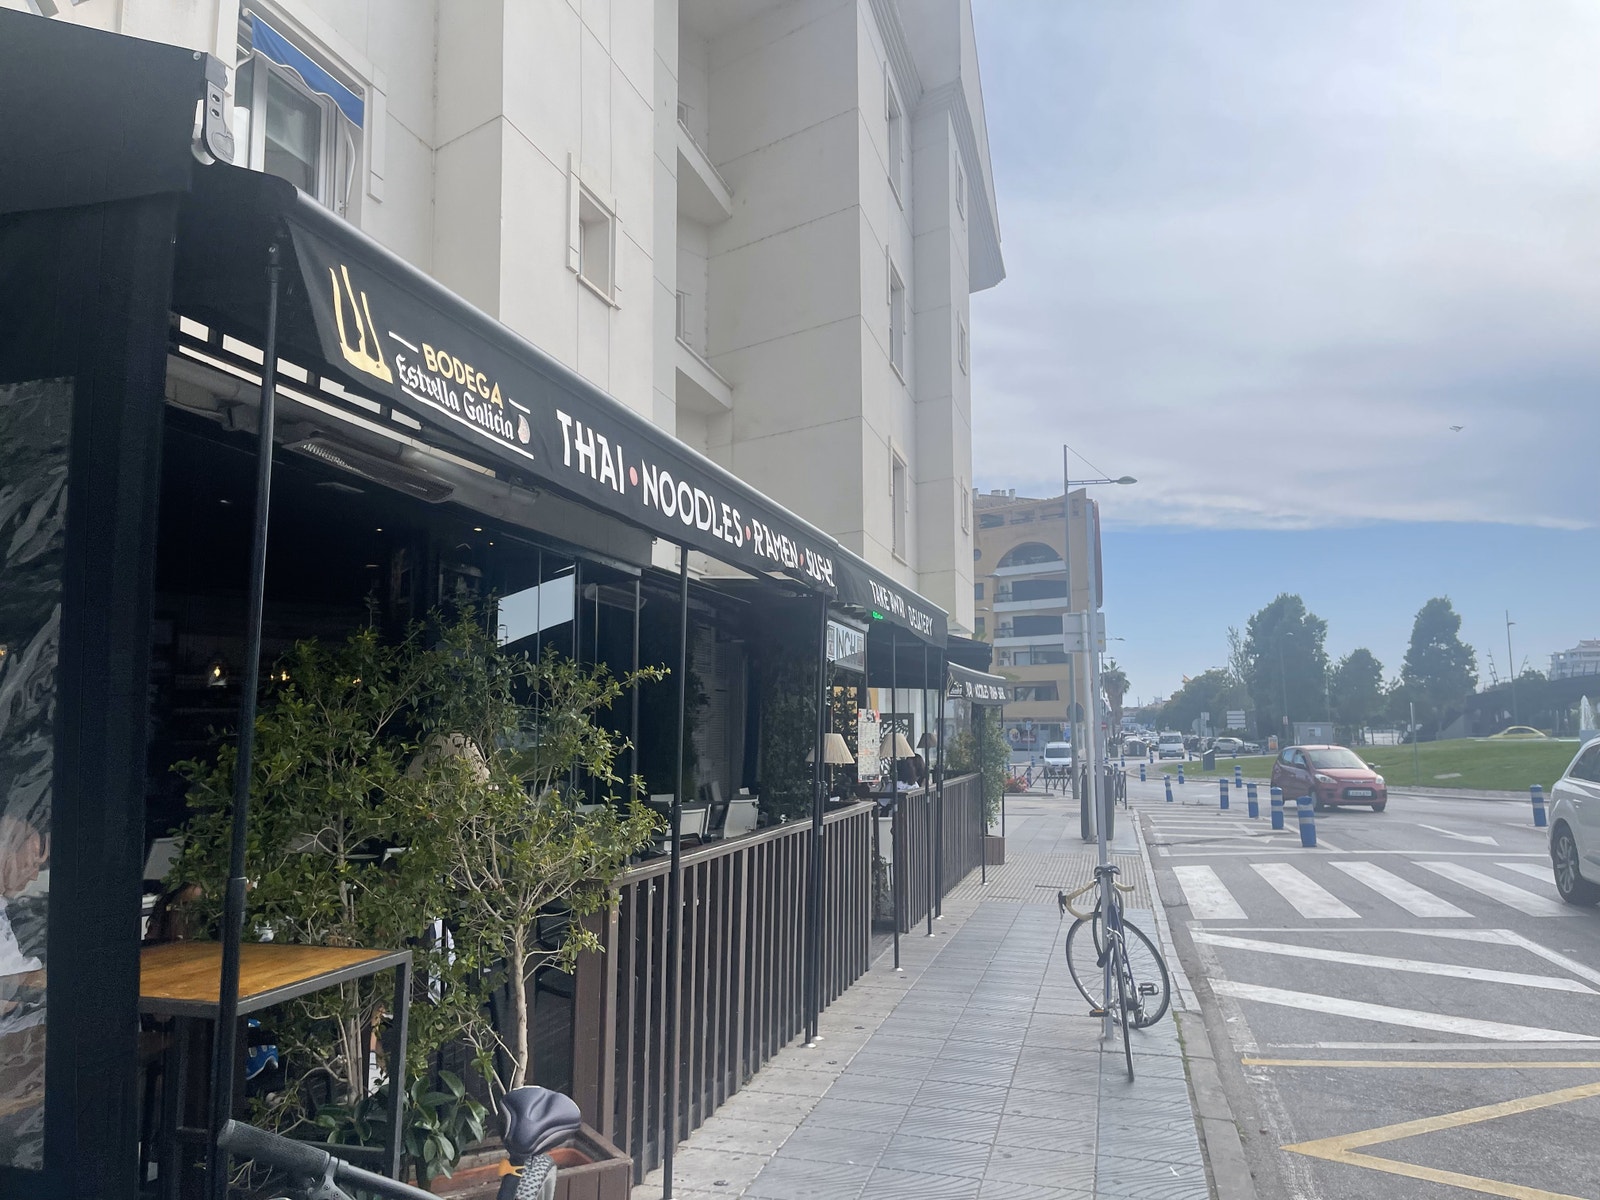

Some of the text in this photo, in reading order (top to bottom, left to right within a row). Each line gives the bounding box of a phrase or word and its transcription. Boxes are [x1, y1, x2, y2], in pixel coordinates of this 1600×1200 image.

[395, 353, 515, 441] Estrella Galicia
[422, 342, 504, 410] BODEGA
[556, 408, 625, 495] THAI
[641, 458, 744, 548] NOODLES
[752, 518, 799, 569] RAMEN
